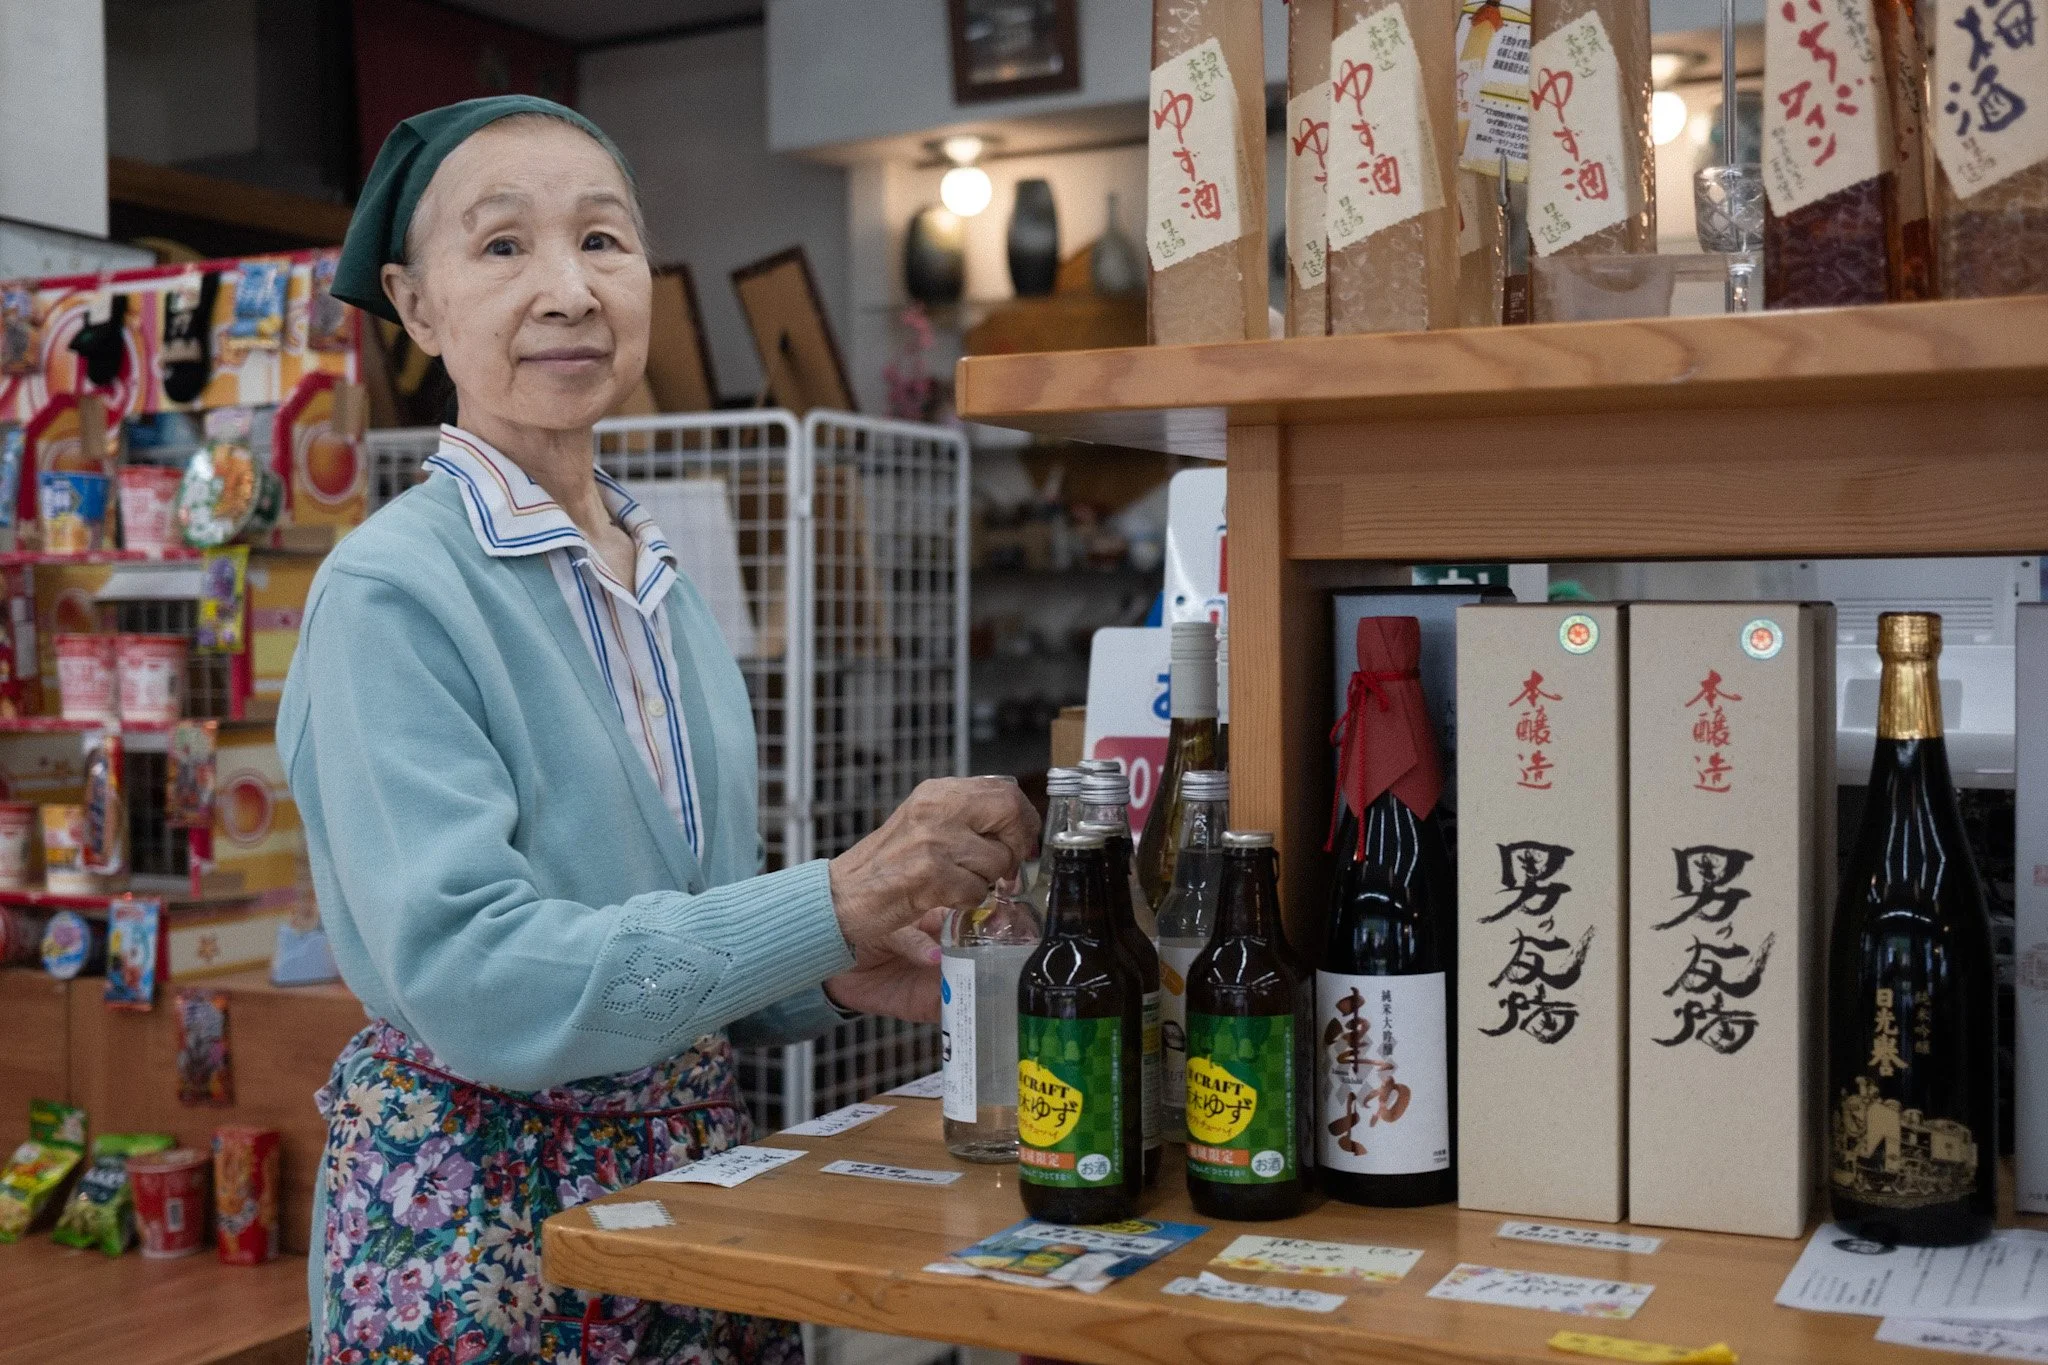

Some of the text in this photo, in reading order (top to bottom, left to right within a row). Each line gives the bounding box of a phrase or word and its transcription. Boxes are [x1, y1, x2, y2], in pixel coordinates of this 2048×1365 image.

[1153, 89, 1221, 221] ゆず酒
[1332, 59, 1401, 196] ゆず酒
[1530, 67, 1609, 201] ゆず酒
[1508, 670, 1563, 790] 本醸造
[1685, 670, 1743, 794] 本醸造
[1381, 989, 1394, 1056] 純米大吟醸
[1868, 987, 1909, 1077] 日光誉
[1024, 1075, 1071, 1098] CRAFT
[1195, 1072, 1245, 1096] CRAFT
[1080, 1160, 1108, 1176] お酒
[1254, 1157, 1281, 1172] お酒
